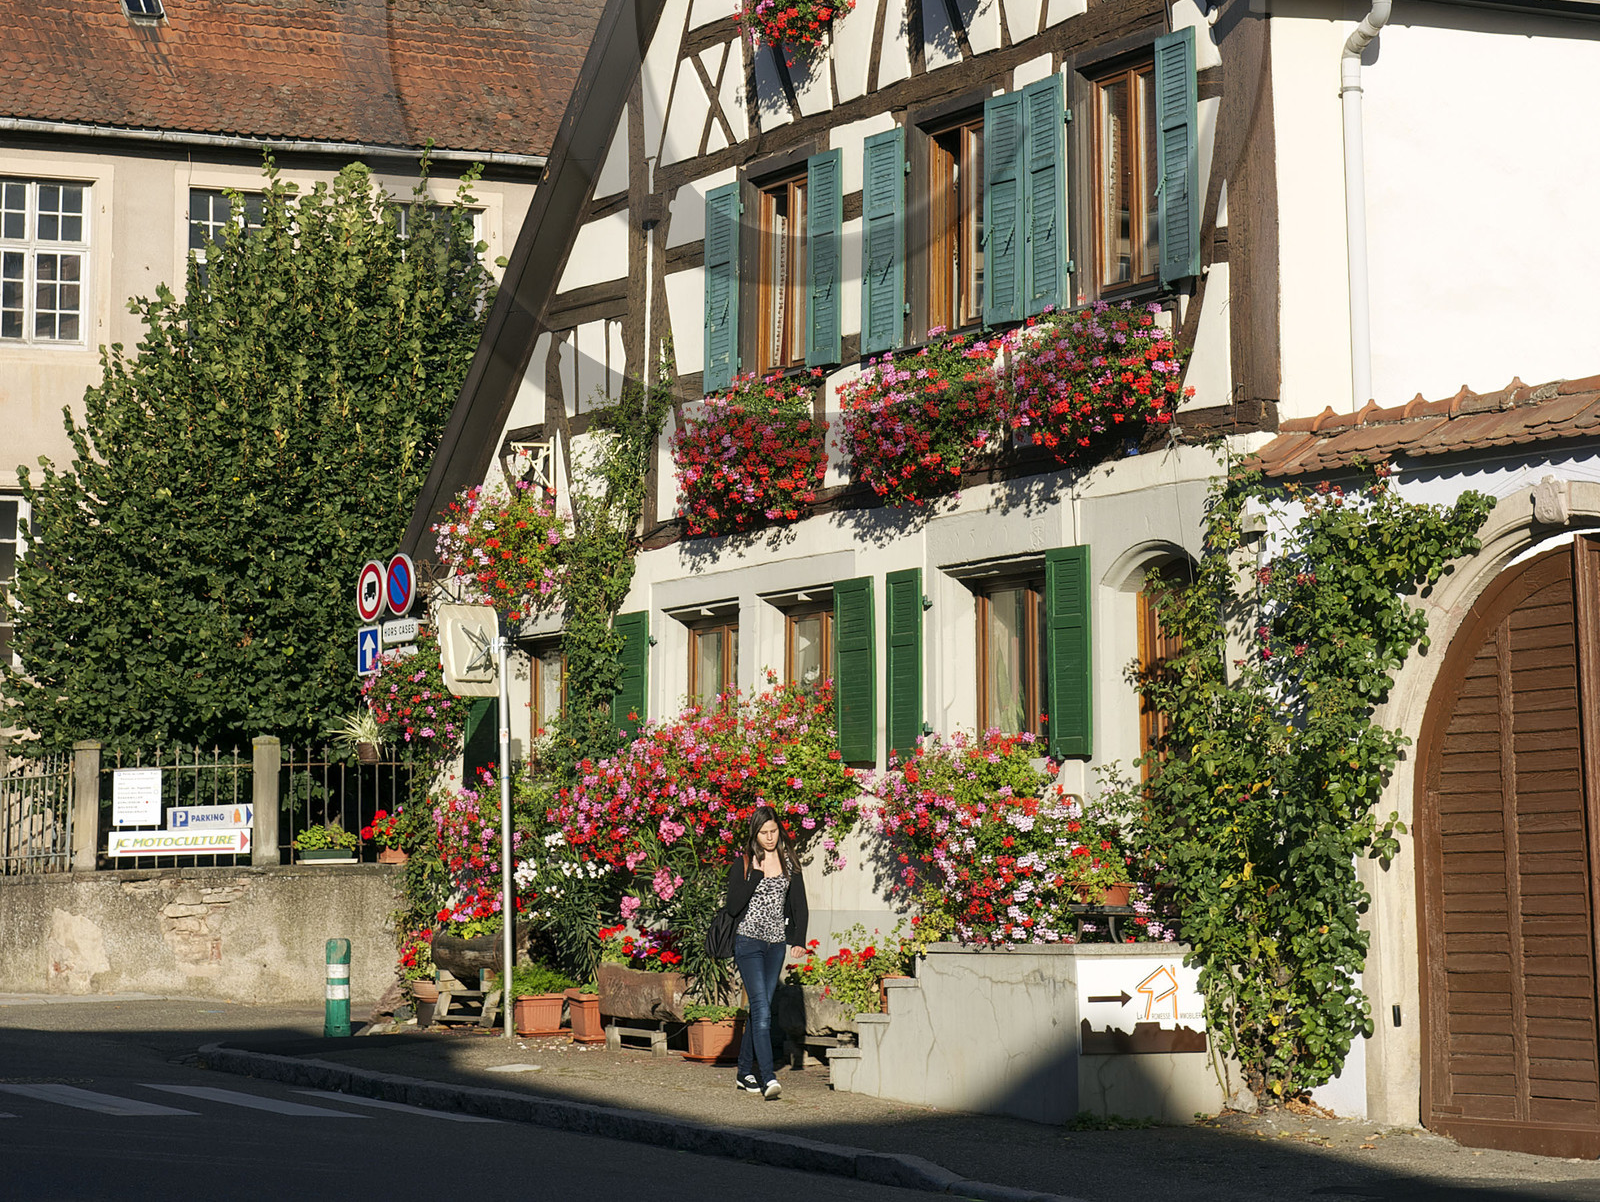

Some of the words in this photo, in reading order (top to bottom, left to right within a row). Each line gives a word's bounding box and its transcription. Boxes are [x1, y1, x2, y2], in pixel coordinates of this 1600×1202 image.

[384, 626, 398, 637] HORS
[398, 624, 415, 635] CASES
[191, 813, 225, 822] PARKING
[113, 838, 132, 850] JC
[132, 835, 237, 847] MOTOCULTURE
